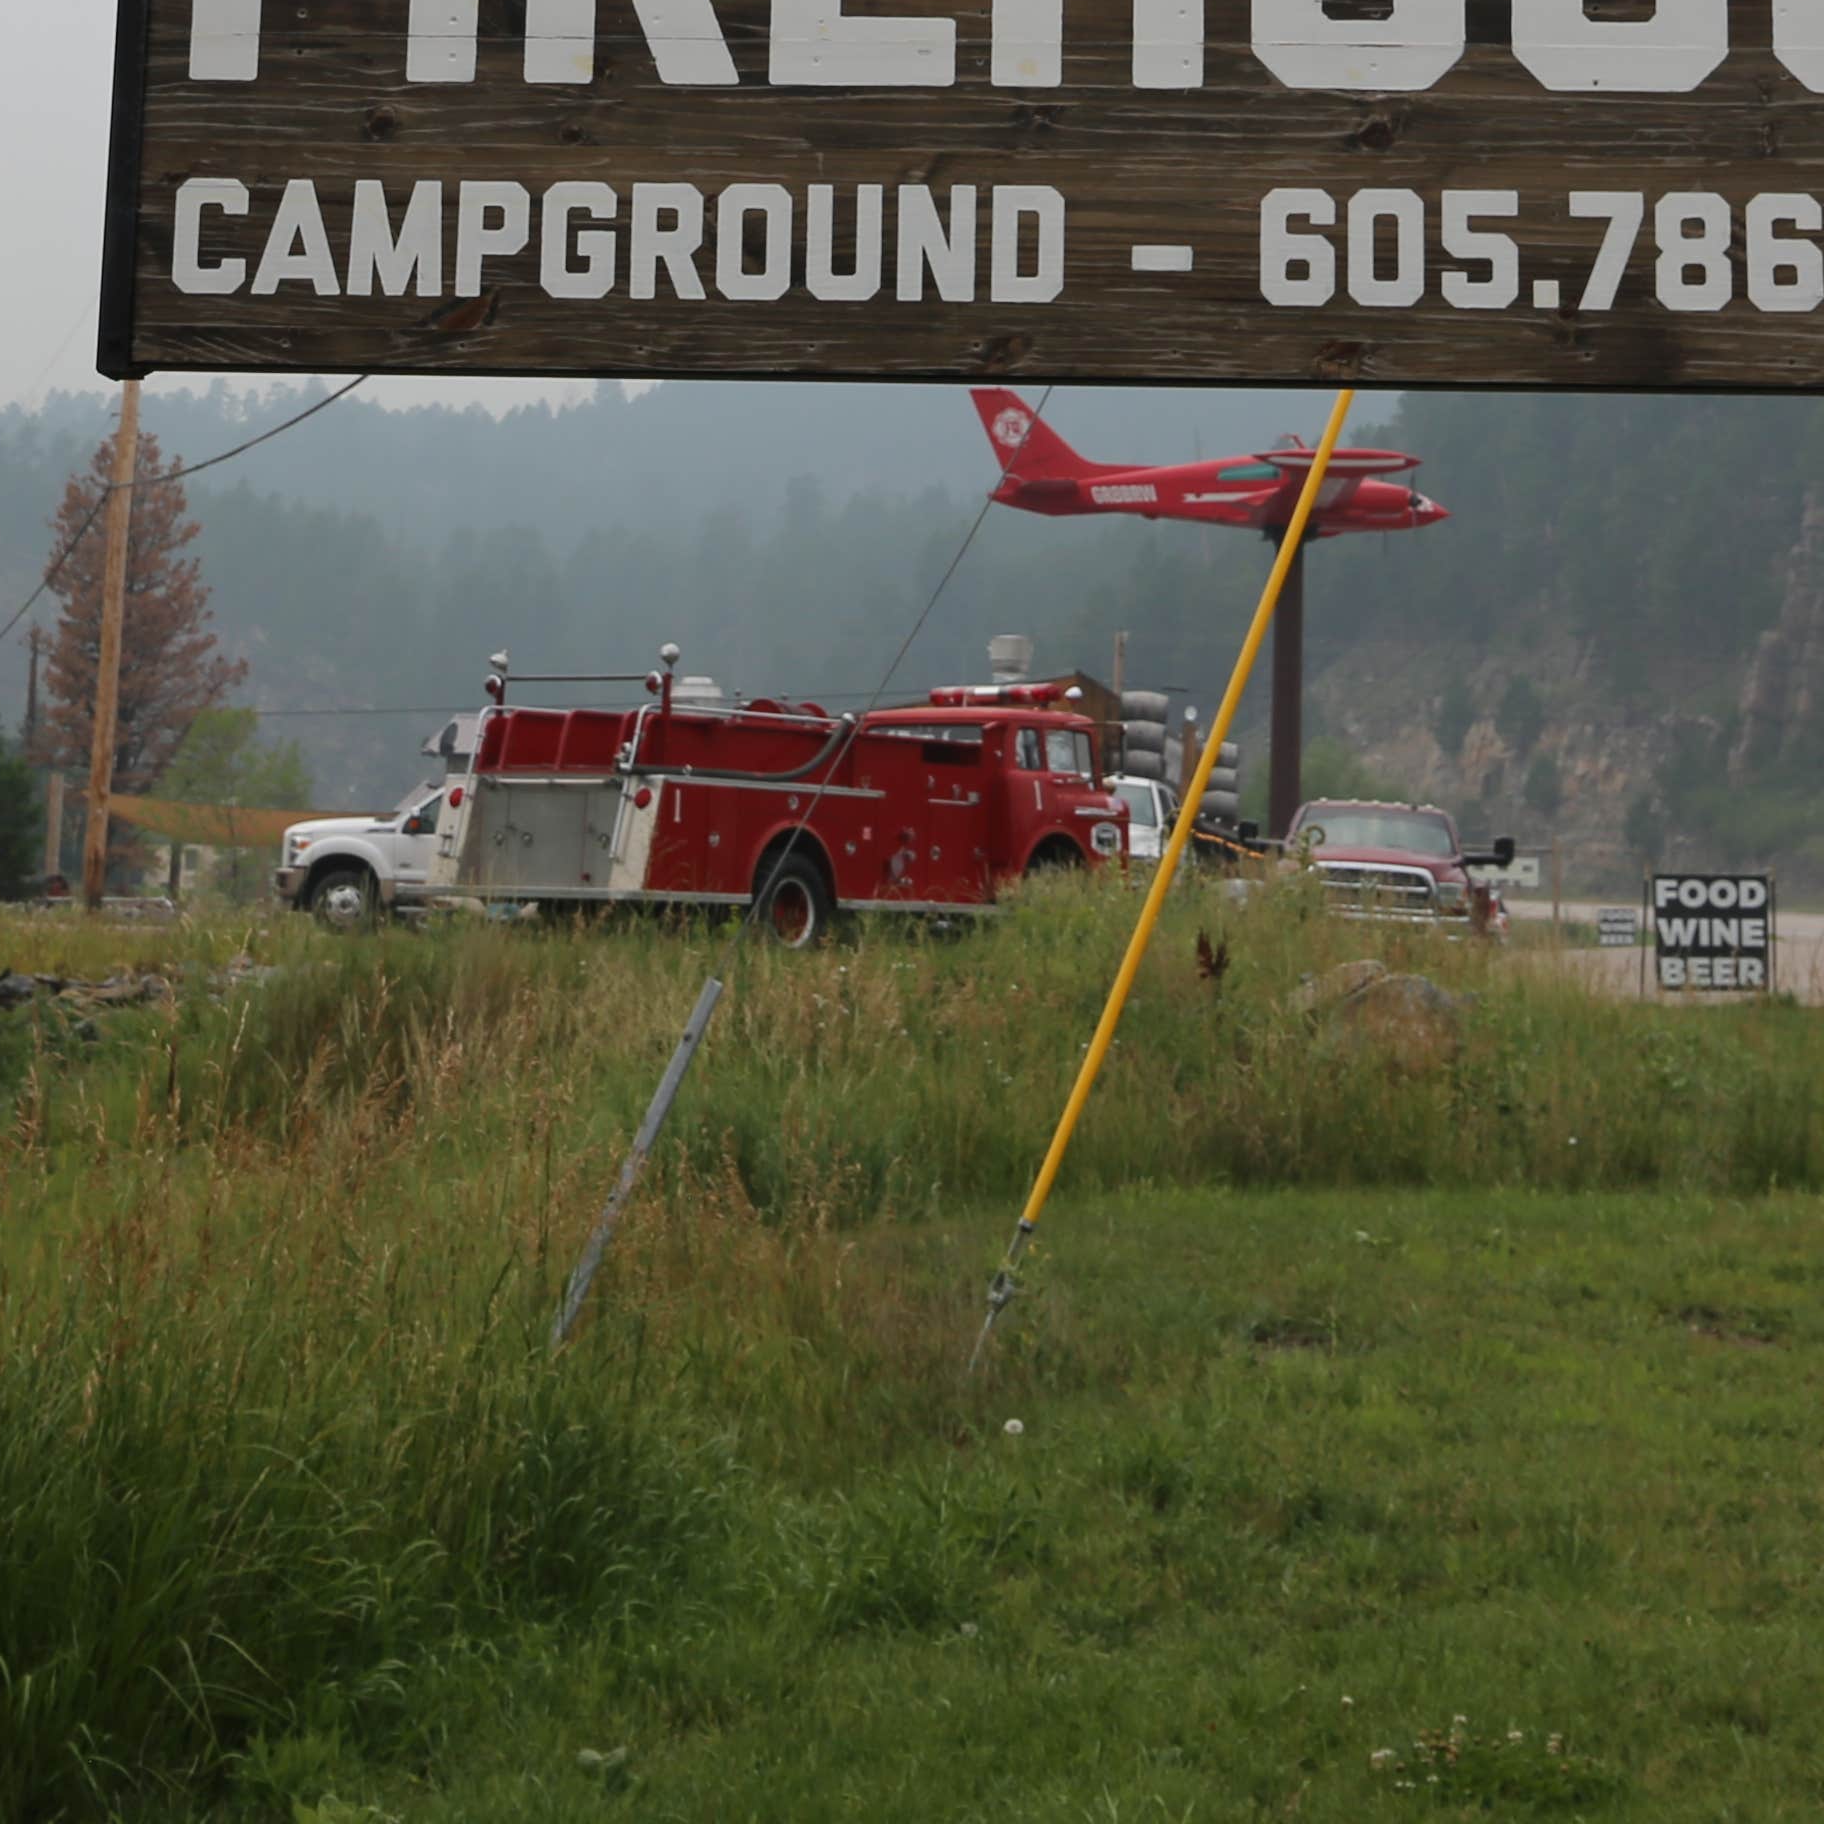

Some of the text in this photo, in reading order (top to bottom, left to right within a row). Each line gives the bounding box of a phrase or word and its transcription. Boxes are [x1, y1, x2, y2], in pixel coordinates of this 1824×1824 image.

[171, 177, 1066, 304] CAMPGROUND
[1654, 878, 1767, 909] FOOD
[1656, 917, 1766, 947] WINE
[1659, 956, 1764, 986] BEER
